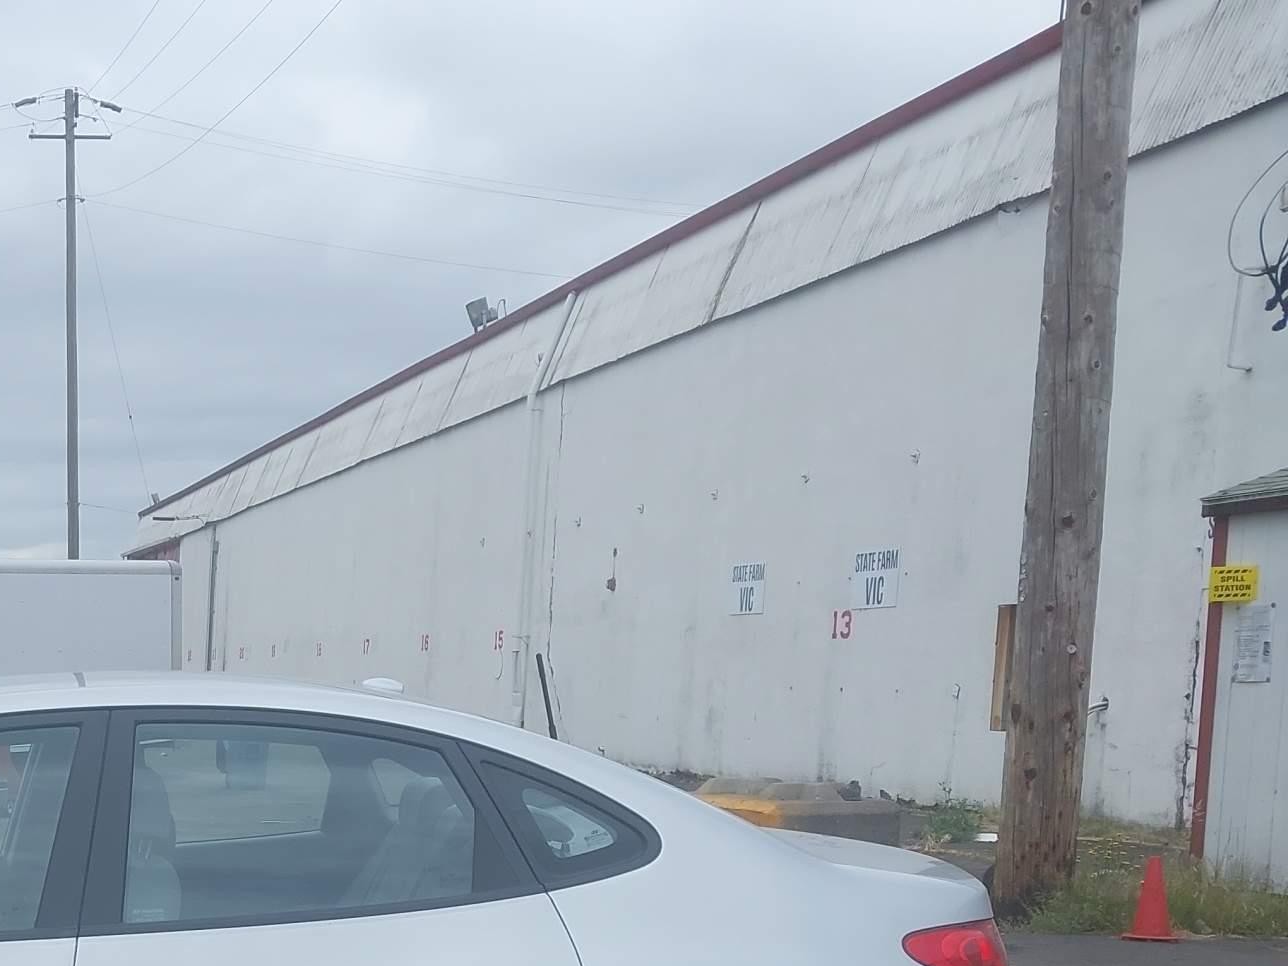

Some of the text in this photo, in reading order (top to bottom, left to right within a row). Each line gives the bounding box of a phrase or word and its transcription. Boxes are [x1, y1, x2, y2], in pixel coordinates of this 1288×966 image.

[855, 549, 899, 573] STATE FARM
[732, 564, 765, 583] STATE FARM
[1220, 575, 1246, 583] SPILL
[865, 576, 885, 605] VIC
[1214, 584, 1251, 592] STATION
[739, 587, 754, 612] VIC
[831, 610, 852, 639] 13
[420, 635, 429, 652] 16
[494, 630, 504, 650] 15
